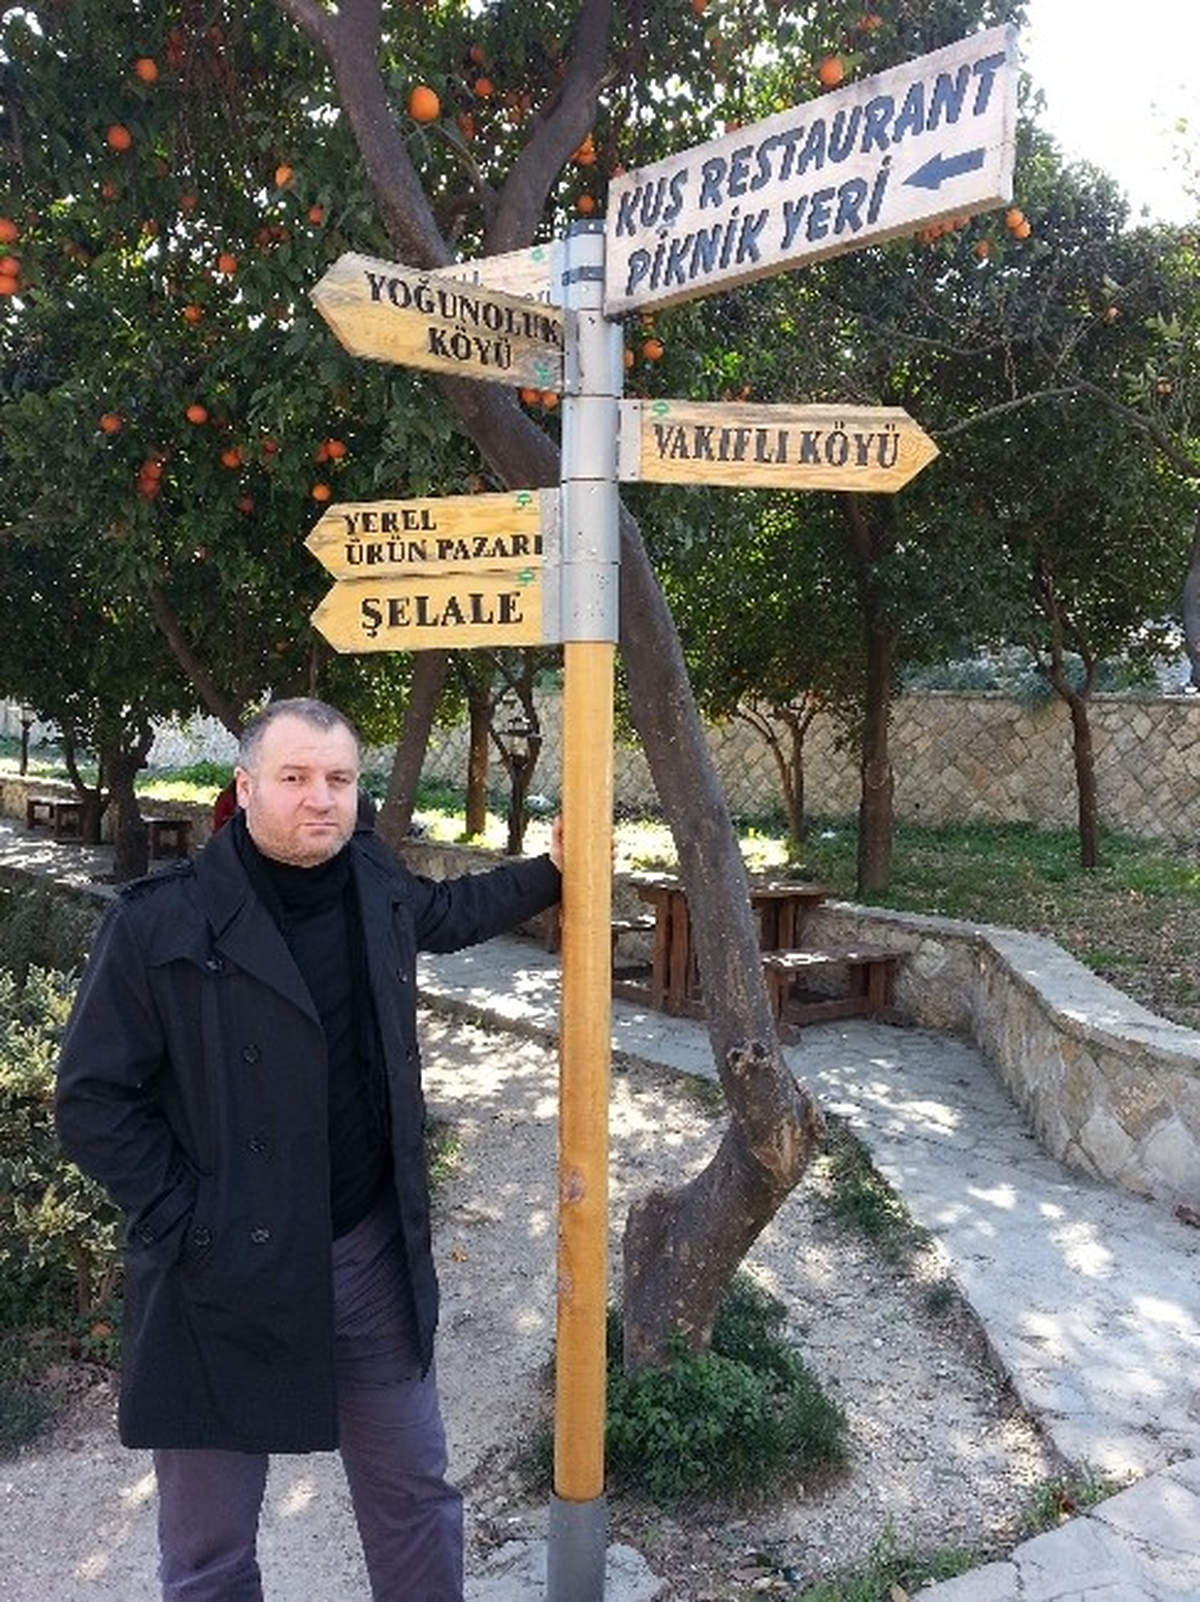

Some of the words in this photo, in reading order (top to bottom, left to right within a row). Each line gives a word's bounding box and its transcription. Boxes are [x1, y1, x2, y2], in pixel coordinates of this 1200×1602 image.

[615, 167, 688, 237] KUŞ
[700, 51, 1006, 210] RESTAURANT
[626, 205, 769, 296] PİKNİK
[781, 155, 893, 250] YERİ
[364, 270, 561, 346] YOĞUNOLUK
[428, 325, 512, 370] KÖYÜ
[653, 423, 789, 464] VAKIFLI
[798, 421, 900, 469] KÖYÜ
[344, 509, 437, 535] YEREL
[344, 536, 427, 565] ÜRÜN
[436, 534, 543, 560] PAZARI
[361, 591, 523, 638] ŞELALE
